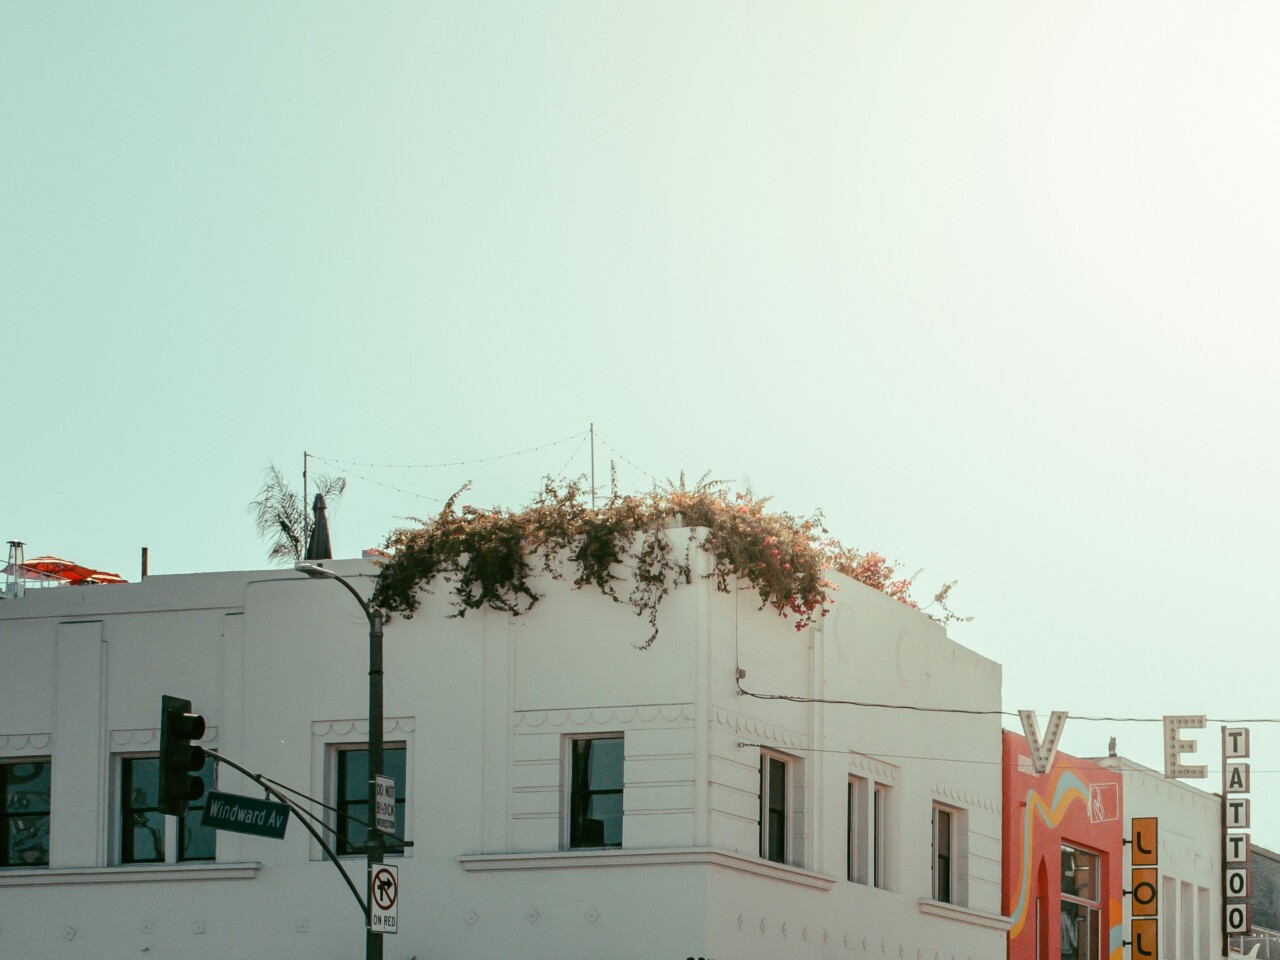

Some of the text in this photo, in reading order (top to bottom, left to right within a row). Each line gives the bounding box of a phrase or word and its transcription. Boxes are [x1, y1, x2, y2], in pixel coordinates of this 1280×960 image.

[376, 783, 395, 799] DO NOT
[210, 799, 284, 828] Windward Av
[1228, 730, 1245, 931] TATTOO
[373, 914, 396, 927] ON RED
